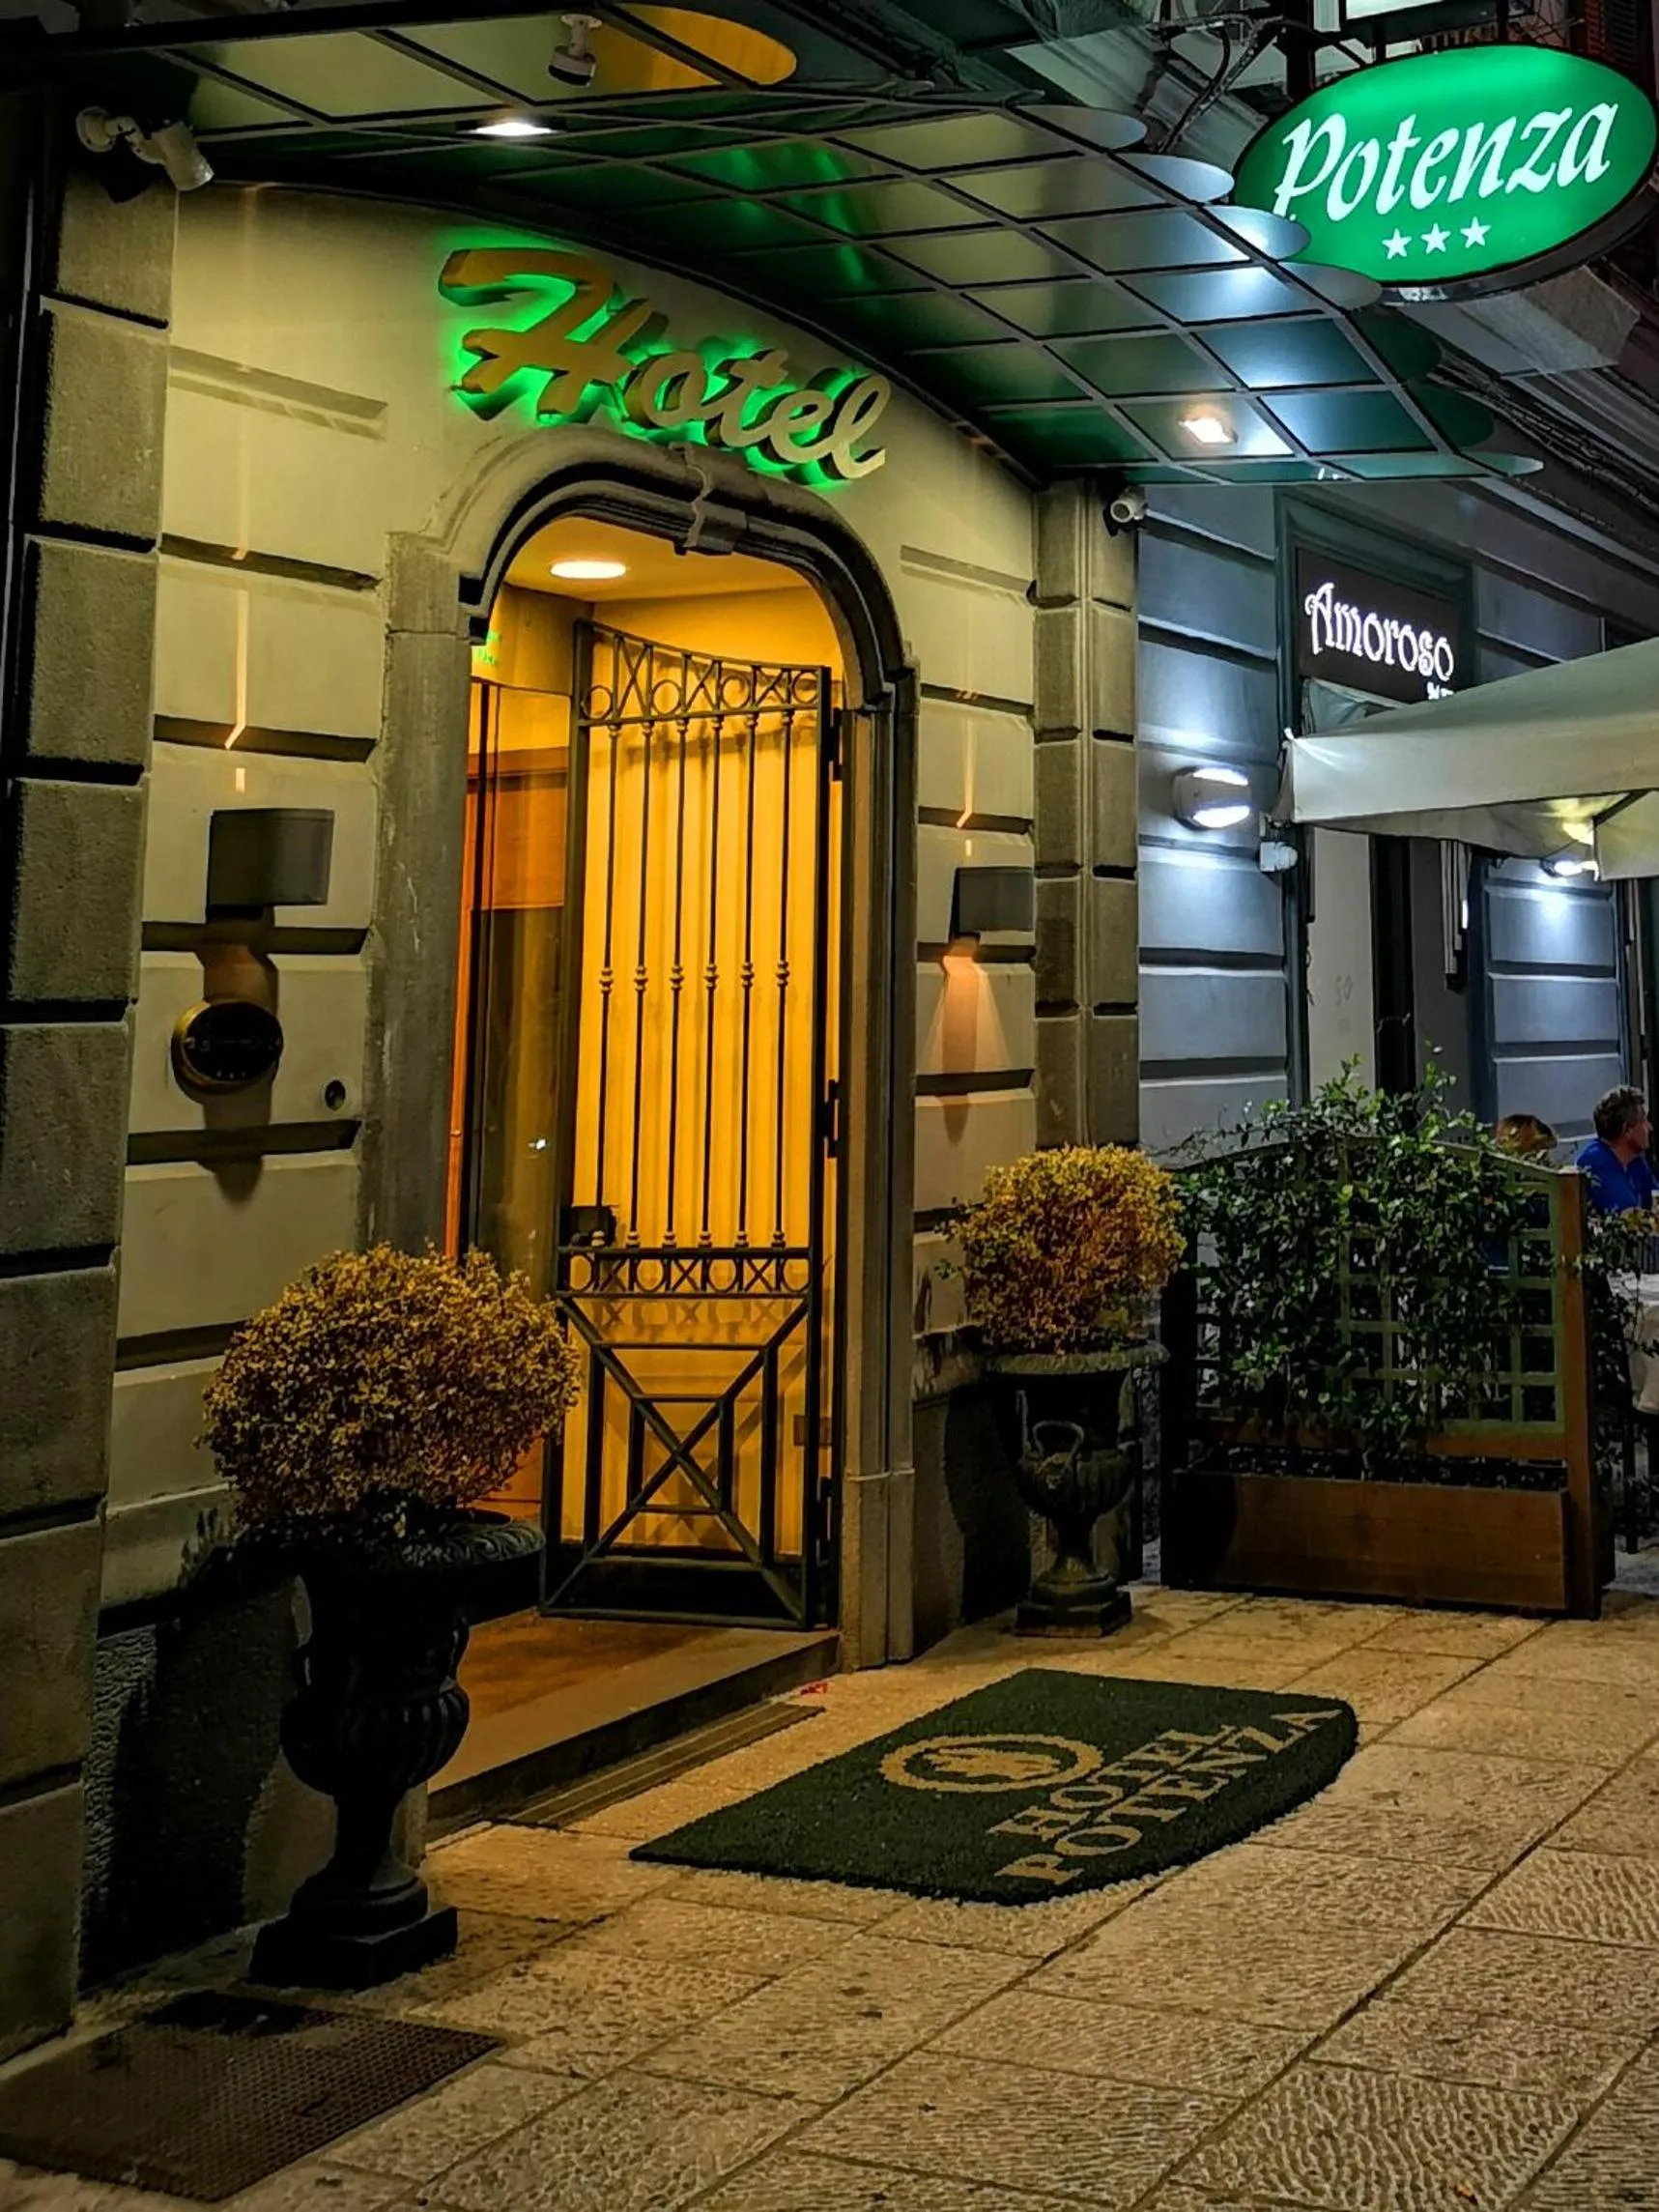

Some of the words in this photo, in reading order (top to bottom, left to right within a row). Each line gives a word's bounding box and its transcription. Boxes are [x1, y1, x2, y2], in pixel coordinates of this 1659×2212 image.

[1272, 101, 1619, 223] Potenza
[439, 247, 892, 480] Hotel
[1303, 582, 1455, 681] Amoroso
[986, 1725, 1237, 1842] HOTEL
[993, 1709, 1343, 1885] POTENZA
